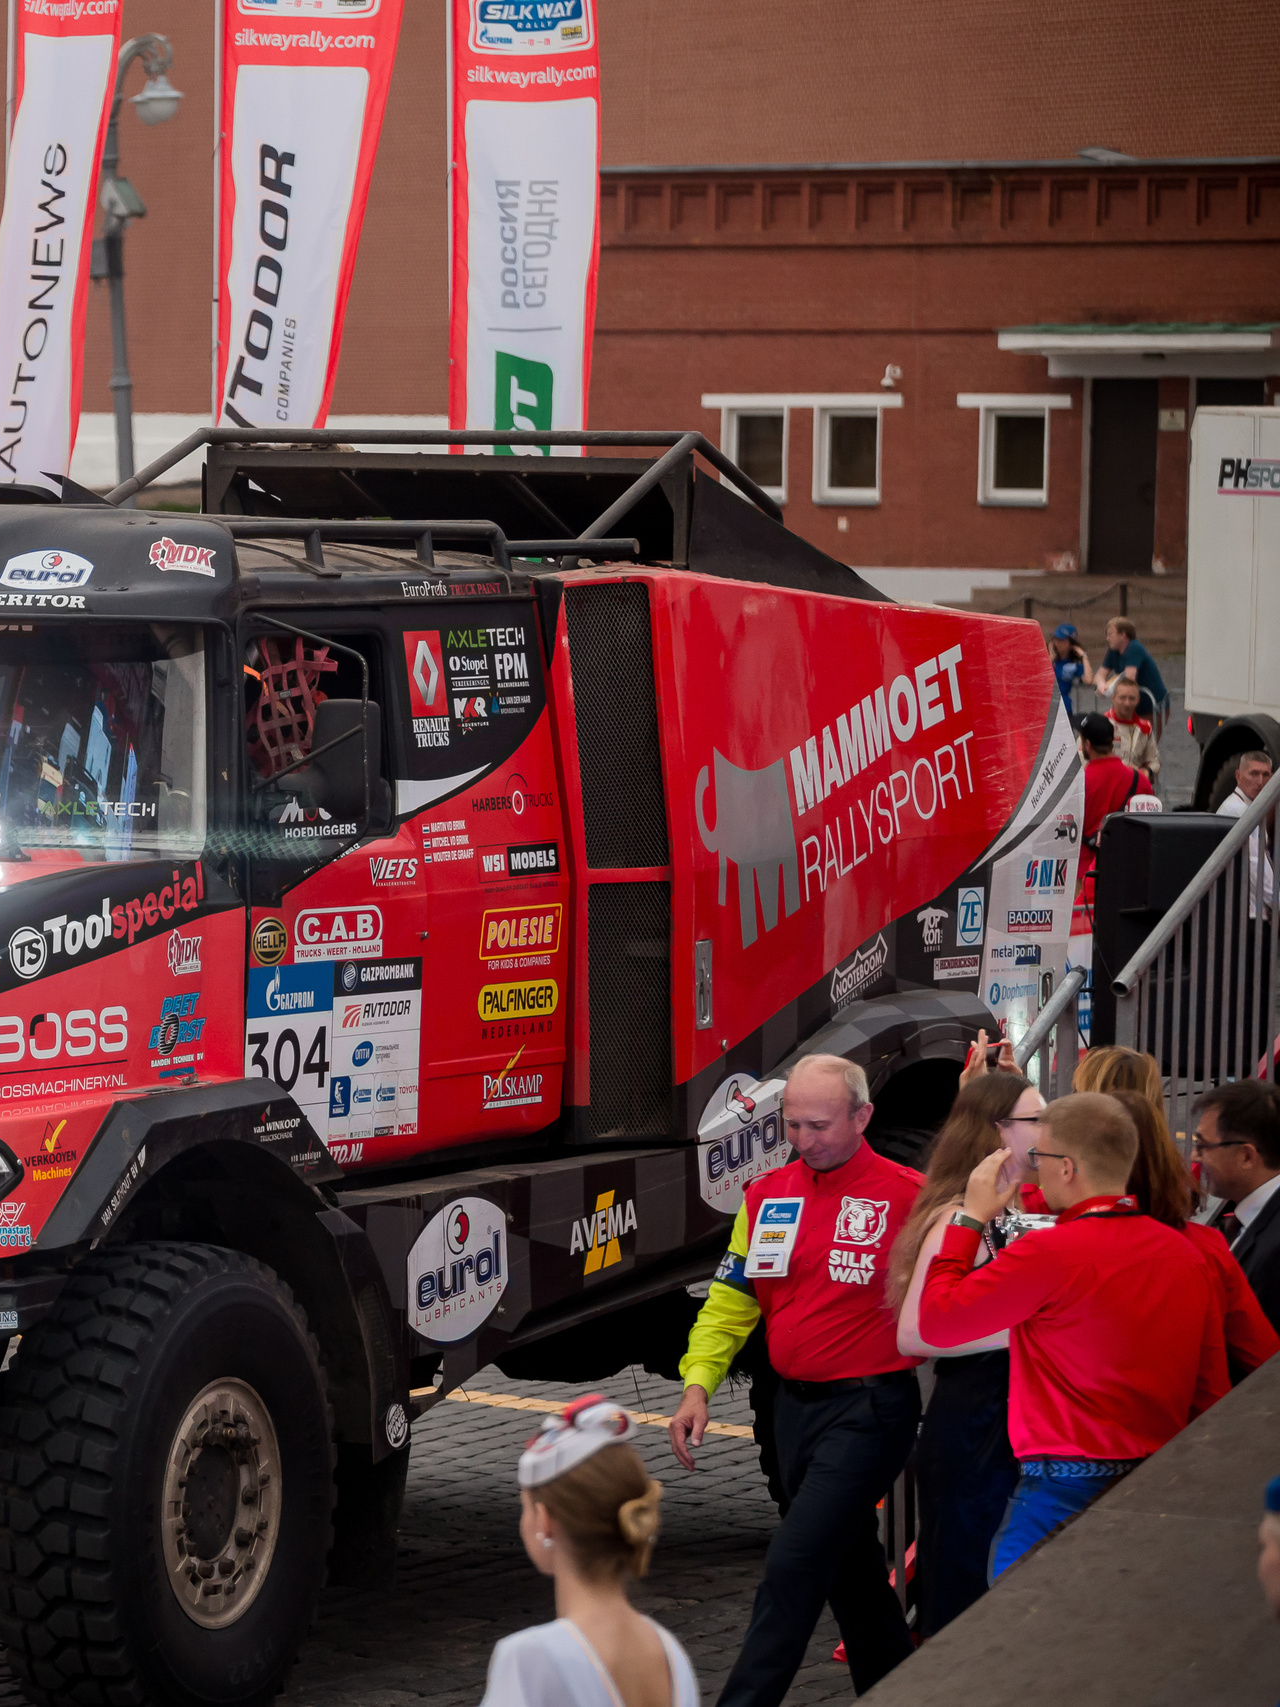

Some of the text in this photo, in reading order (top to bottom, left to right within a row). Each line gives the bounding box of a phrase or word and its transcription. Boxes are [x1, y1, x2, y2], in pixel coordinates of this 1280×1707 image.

[484, 0, 577, 20] SILK WAY
[516, 20, 553, 29] RALLY
[234, 28, 375, 52] silkwayrally.com
[467, 65, 596, 88] silkwayrally.com
[494, 179, 522, 309] РОССИЯ
[521, 179, 559, 308] СЕГОДНЯ
[276, 317, 297, 421] COMPANIES
[166, 545, 216, 567] MDK
[8, 567, 86, 584] eurol
[448, 582, 501, 596] TRUCK PAINT
[447, 627, 525, 648] AXLETECH
[461, 654, 488, 675] Stopel
[494, 653, 529, 680] FPM
[412, 717, 450, 733] RENAULT
[789, 644, 964, 817] MAMMOET
[415, 732, 450, 748] TRUCKS
[40, 801, 156, 817] AXLETECH
[472, 792, 554, 812] HARBERS TRUCKS
[802, 730, 974, 903] RALLYSPORT
[285, 823, 357, 838] HOEDLIGGERS
[431, 834, 470, 848] MITCHEL BRINK
[482, 848, 557, 873] WSI MODELS
[369, 858, 418, 886] VIETS
[1025, 858, 1068, 889] SNK
[43, 861, 205, 955] Toolspecial
[961, 902, 982, 932] ZF
[1007, 910, 1052, 925] BADOUX
[302, 913, 374, 943] C.A.B
[486, 915, 554, 949] POLESIE
[176, 936, 202, 966] MDK
[256, 933, 286, 950] HELLA
[296, 945, 381, 958] TRUCKS WEERT HOLLAND
[13, 938, 41, 969] TS
[487, 959, 500, 970] FOR
[500, 958, 514, 969] KIDS
[519, 955, 551, 968] COMPANIES
[360, 963, 415, 982] GAZPROMBANK
[835, 948, 883, 999] NOOTEBOOM
[280, 990, 314, 1010] GAZPROM
[483, 985, 553, 1015] PALFINGER
[837, 969, 883, 1011] SPECIAL TRAILERS
[1001, 982, 1037, 1002] Dopharma
[160, 992, 201, 1020] PEET
[362, 1000, 411, 1018] AVTODOR
[148, 1016, 207, 1055] BORST
[481, 1020, 553, 1040] NEDERLAND
[151, 1052, 204, 1068] BANDEN TECHNIEK BV
[248, 1025, 330, 1093] 304
[355, 1048, 371, 1061] ОПТИ
[399, 1085, 418, 1095] TOYOTA
[483, 1074, 543, 1100] POLSKAMP
[253, 1118, 301, 1134] van WINKOOP
[707, 1098, 787, 1183] eurol
[24, 1150, 77, 1168] VERKOOYEN
[32, 1166, 73, 1182] Machines
[707, 1148, 787, 1201] LUBRICANTS
[100, 1206, 114, 1226] VAN
[130, 1163, 138, 1179] BV
[570, 1199, 638, 1256] AVEMA
[416, 1229, 502, 1311] eurol
[829, 1249, 876, 1270] SILK
[828, 1265, 875, 1285] WAY
[415, 1282, 503, 1326] LUBRICANTS
